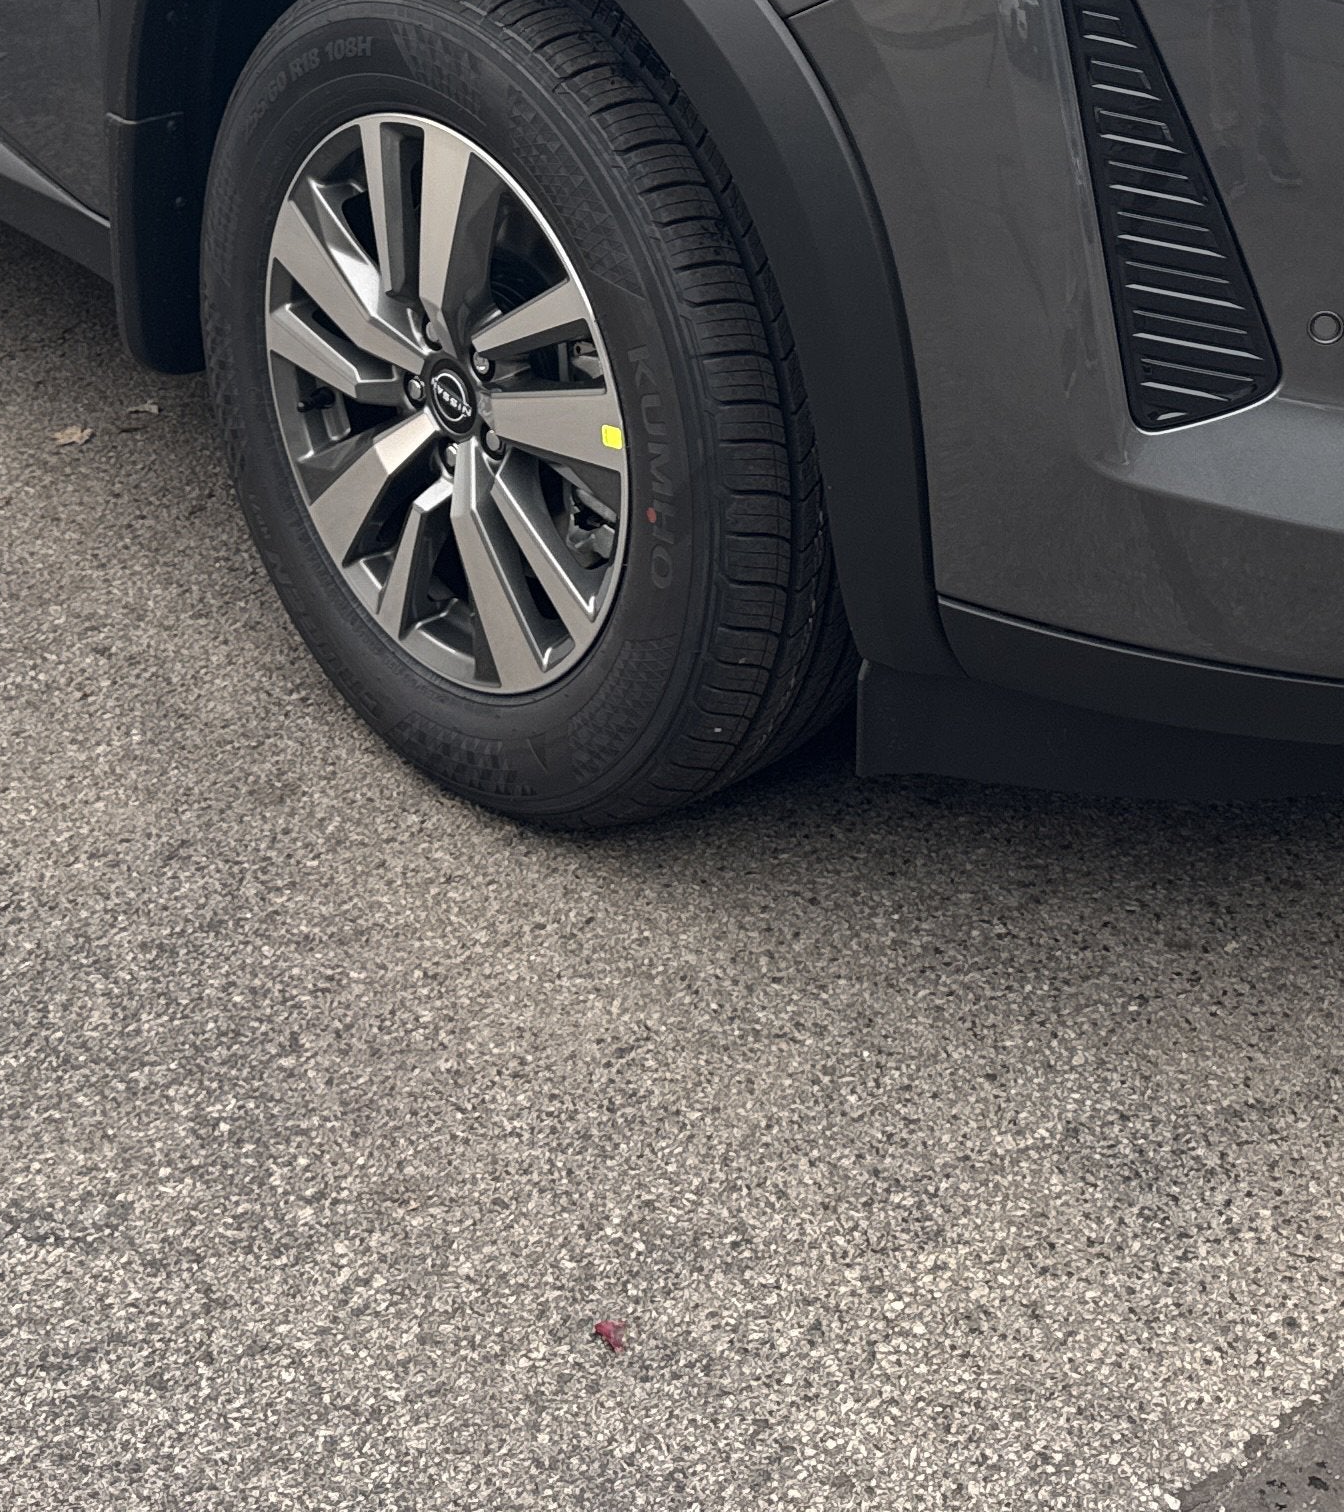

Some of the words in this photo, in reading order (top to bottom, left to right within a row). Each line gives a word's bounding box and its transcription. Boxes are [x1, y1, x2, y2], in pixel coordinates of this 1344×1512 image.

[288, 47, 321, 81] R18
[324, 35, 374, 62] 108H
[627, 344, 675, 590] KUMHO
